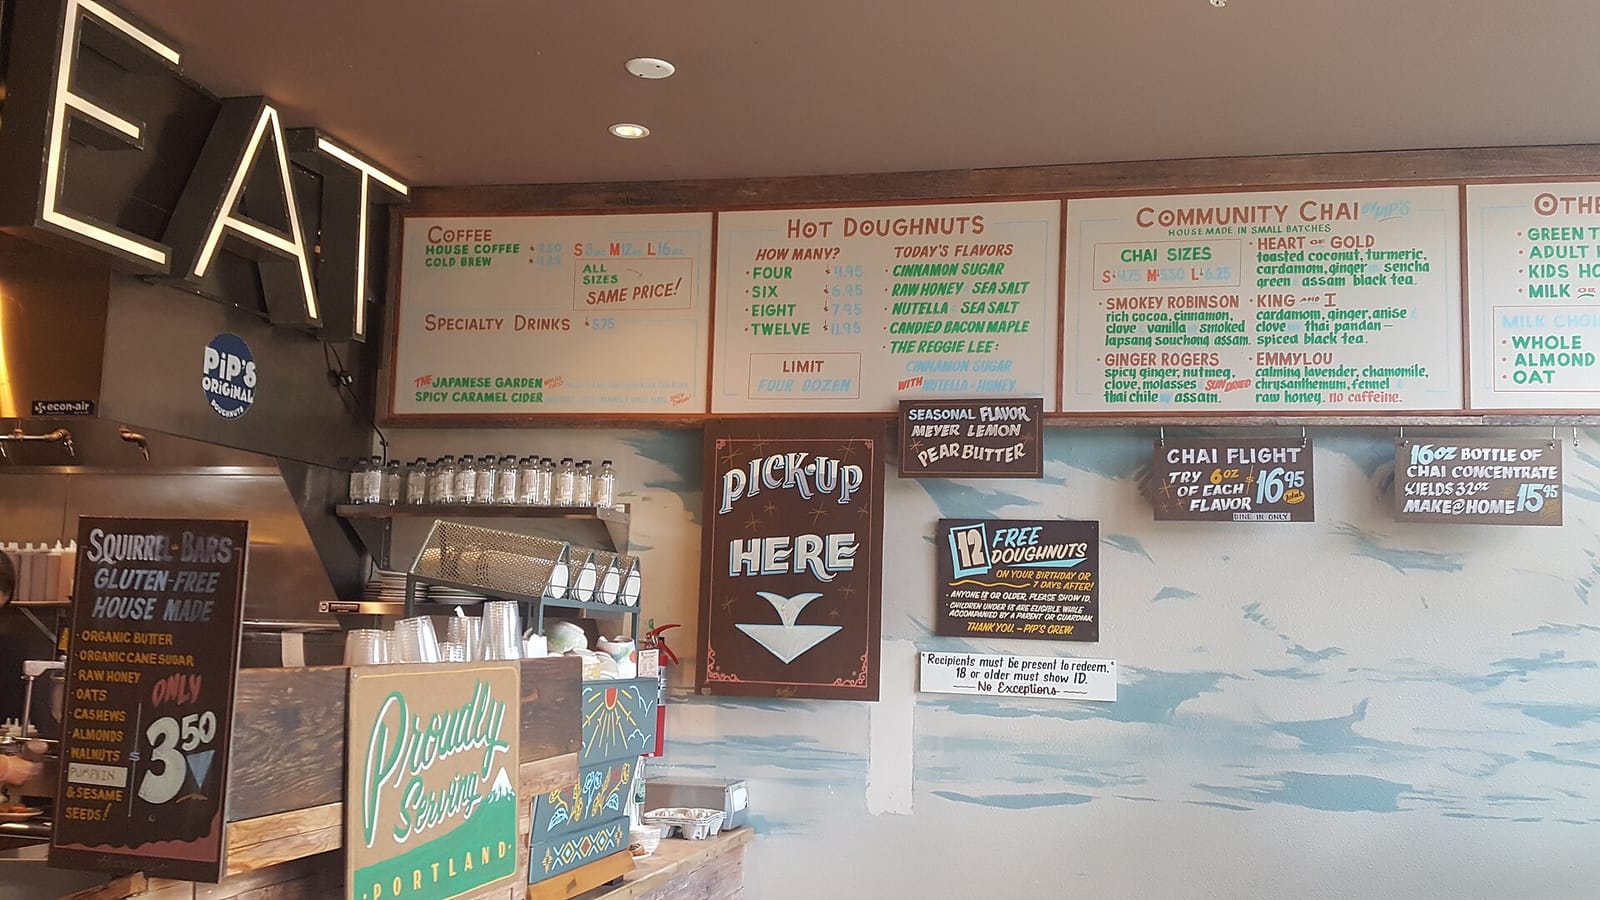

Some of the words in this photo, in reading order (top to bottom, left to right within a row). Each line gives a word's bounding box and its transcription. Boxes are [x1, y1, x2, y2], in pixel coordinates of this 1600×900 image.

[40, 0, 408, 337] EAT
[1136, 205, 1288, 228] COMMUNITY
[1300, 200, 1358, 222] CHAI
[787, 219, 833, 239] HOT
[844, 215, 985, 237] DOUGHNUTS
[1168, 228, 1201, 237] HOUSE
[1205, 227, 1233, 236] MADE
[1251, 225, 1282, 234] SMALL
[1286, 224, 1331, 233] BATCHES
[1527, 227, 1584, 241] GREEN
[428, 226, 492, 244] COFFEE
[426, 244, 469, 255] HOUSE
[474, 243, 520, 254] COFFEE
[1257, 236, 1306, 251] HEART
[1330, 235, 1375, 249] GOLD
[755, 248, 789, 260] HOW
[792, 247, 840, 260] MANY?
[894, 244, 949, 258] TODAY'S
[954, 243, 1014, 257] FLAVORS
[1121, 248, 1158, 262] CHAI
[1167, 247, 1212, 261] SIZES
[1256, 250, 1304, 263] toasted
[1529, 245, 1589, 259] ADULT
[425, 257, 456, 267] COLD
[460, 257, 491, 267] BREW
[582, 264, 607, 273] ALL
[1329, 262, 1367, 276] ginger
[1384, 260, 1430, 273] sencha
[752, 266, 793, 279] FOUR
[892, 263, 959, 277] CINNAMON
[961, 262, 1005, 276] SUGAR
[1528, 264, 1569, 278] KIDS
[582, 275, 619, 285] SIZES
[1256, 276, 1291, 288] green
[1302, 276, 1345, 287] assam
[1352, 273, 1387, 286] black
[586, 287, 628, 304] SAME
[632, 277, 683, 300] PRICE!
[752, 285, 778, 298] SIX
[891, 282, 920, 297] RAW
[920, 282, 964, 296] HONEY
[972, 281, 997, 294] SEA
[997, 281, 1030, 294] SALT
[1528, 283, 1571, 298] MILK
[1106, 296, 1163, 310] SMOKEY
[1168, 295, 1239, 309] ROBINSON
[1257, 294, 1296, 307] KING
[751, 303, 797, 317] EIGHT
[892, 302, 948, 315] NUTELLA
[961, 301, 985, 314] SEA
[987, 301, 1020, 314] SALT
[425, 314, 504, 331] SPECIALTY
[514, 314, 570, 331] DRINKS
[1106, 311, 1129, 322] rich
[751, 322, 810, 336] TWELVE
[890, 320, 942, 334] CANDIED
[943, 320, 986, 333] BACON
[986, 320, 1030, 333] MAPLE
[1147, 321, 1186, 334] vanilla
[1199, 320, 1246, 333] smoked
[1304, 332, 1338, 345] black
[1511, 335, 1581, 349] WHOLE
[890, 340, 917, 353] THE
[917, 340, 965, 353] REGGIE
[1104, 353, 1157, 366] GINGER
[1161, 352, 1219, 366] ROGERS
[1256, 352, 1333, 366] EMMYLOU
[1514, 353, 1595, 367] ALMOND
[783, 360, 824, 373] LIMIT
[1104, 367, 1137, 380] spicy
[432, 377, 491, 388] JAPANESE
[495, 377, 543, 388] GARDEN
[1512, 370, 1555, 384] OAT
[757, 379, 794, 392] FOUR
[802, 378, 852, 392] DOZEN
[415, 391, 448, 403] SPICY
[452, 391, 508, 403] CARAMEL
[511, 392, 543, 403] CIDER
[1255, 392, 1280, 403] raw
[47, 401, 90, 411] econ-air
[908, 408, 976, 421] SEASONAL
[980, 406, 1031, 422] FLAVOR
[911, 424, 960, 438] MEYER
[967, 424, 1022, 438] LEMON
[917, 442, 960, 468] PEAR
[961, 443, 1026, 463] BUTTER
[1167, 448, 1218, 464] CHAI
[1227, 447, 1302, 464] FLIGHT
[1460, 448, 1518, 462] BOTTLE
[1519, 449, 1543, 461] OF
[1168, 471, 1202, 484] TRY
[1406, 465, 1447, 478] CHAI
[1451, 466, 1558, 480] CONCENTRATE
[1177, 486, 1199, 497] OF
[1202, 484, 1245, 497] EACH
[1189, 497, 1252, 512] FLAVOR
[87, 528, 174, 564] SQUIRREL
[180, 531, 233, 564] BARS
[957, 528, 986, 567] 12
[992, 526, 1043, 547] FREE
[729, 533, 860, 582] HERE
[991, 543, 1087, 565] DOUGHNUTS
[94, 568, 221, 593] GLUTEN-FREE
[1011, 570, 1035, 579] YOUR
[1036, 571, 1077, 580] BIRTHDAY
[1040, 581, 1062, 590] DAYS
[951, 590, 981, 599] ANYONE
[1029, 593, 1055, 601] PLEASE
[1057, 594, 1080, 602] SHOW
[92, 596, 157, 621] HOUSE
[163, 599, 215, 622] MADE
[949, 602, 982, 610] CHILDREN
[983, 603, 1006, 611] UNDER
[1030, 605, 1061, 613] ELIGIBLE
[949, 610, 998, 619] ACCOMPANIED
[1016, 612, 1042, 620] PARENT
[967, 621, 993, 632] THANK
[81, 630, 131, 642] ORGANIC
[133, 632, 173, 645] BUTTER
[79, 650, 126, 663] ORGANIC
[126, 652, 157, 665] CANE
[159, 654, 194, 667] SUGAR
[979, 657, 1004, 668] must
[1007, 657, 1019, 669] be
[1021, 659, 1059, 671] present
[1060, 660, 1070, 671] to
[78, 669, 104, 681] RAW
[107, 671, 141, 683] HONEY
[956, 667, 966, 678] 18
[970, 669, 981, 678] or
[984, 669, 1010, 680] older
[1013, 671, 1038, 681] must
[1043, 672, 1069, 683] show
[76, 689, 108, 701] OATS
[152, 673, 203, 707] ONLY
[977, 681, 992, 692] No
[998, 682, 1058, 695] Exceptions
[74, 708, 127, 722] CASHEWS
[72, 728, 125, 742] ALMONDS
[70, 747, 121, 761] WALNUTS
[362, 678, 509, 848] Proudly
[71, 766, 115, 781] PUMPKIN
[77, 788, 123, 801] SESAME
[65, 802, 113, 821] SEEDS!
[393, 770, 482, 843] Serving
[373, 841, 506, 900] PORTLAND
